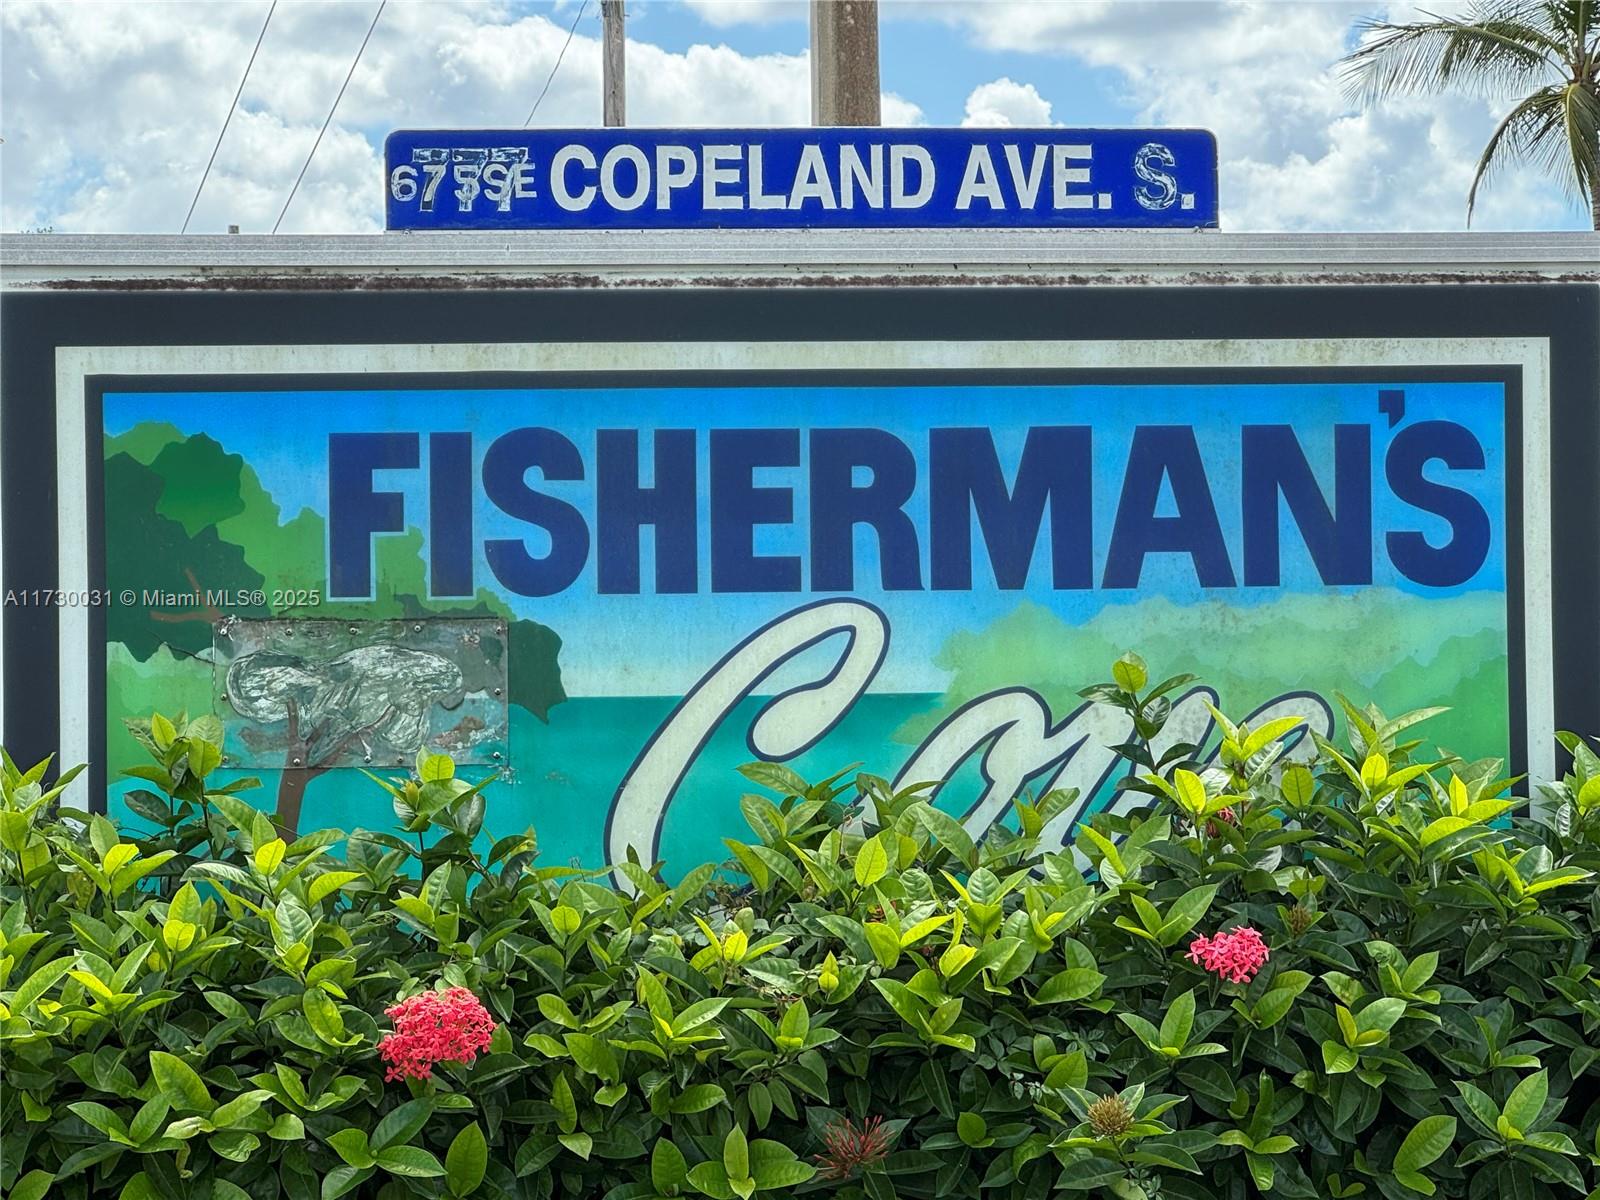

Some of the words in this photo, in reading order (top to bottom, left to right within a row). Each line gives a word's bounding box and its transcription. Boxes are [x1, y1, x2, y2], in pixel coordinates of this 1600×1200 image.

[549, 143, 935, 212] COPELAND
[954, 143, 1112, 210] AVE.
[1133, 142, 1196, 212] S.
[328, 389, 1492, 602] FISHERMAN'S
